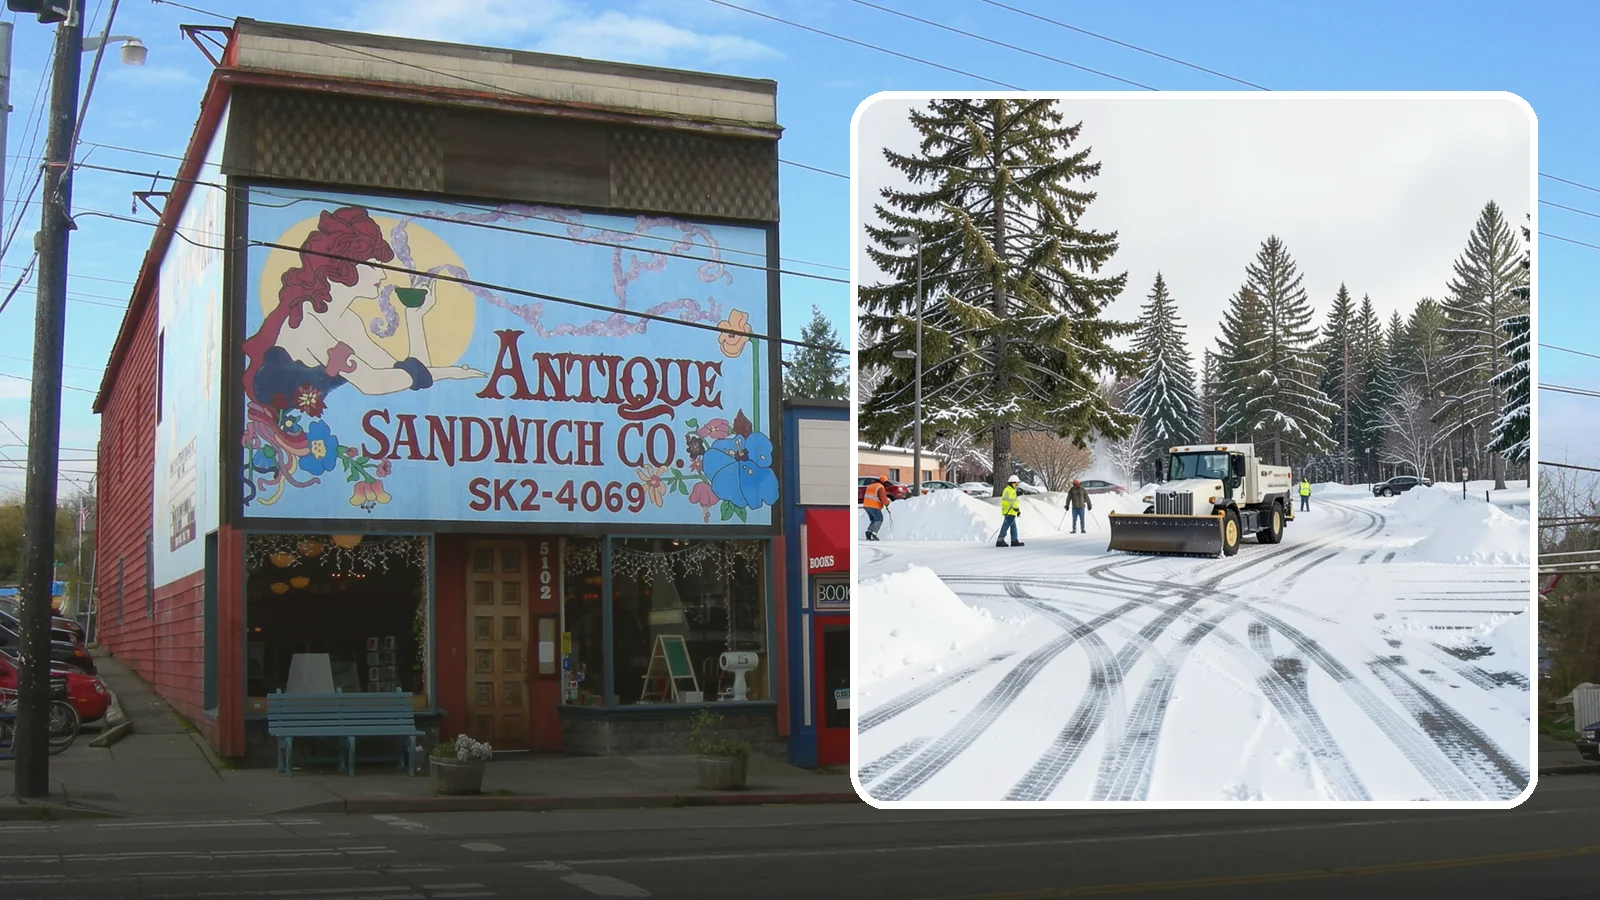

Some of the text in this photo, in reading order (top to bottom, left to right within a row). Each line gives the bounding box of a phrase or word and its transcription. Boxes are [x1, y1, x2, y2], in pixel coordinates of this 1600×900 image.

[476, 329, 724, 421] ANTIQUE
[361, 408, 685, 469] SANDWICH CO.
[468, 477, 646, 512] SK2-4069
[539, 542, 552, 600] 5102
[809, 555, 835, 569] BOOKS
